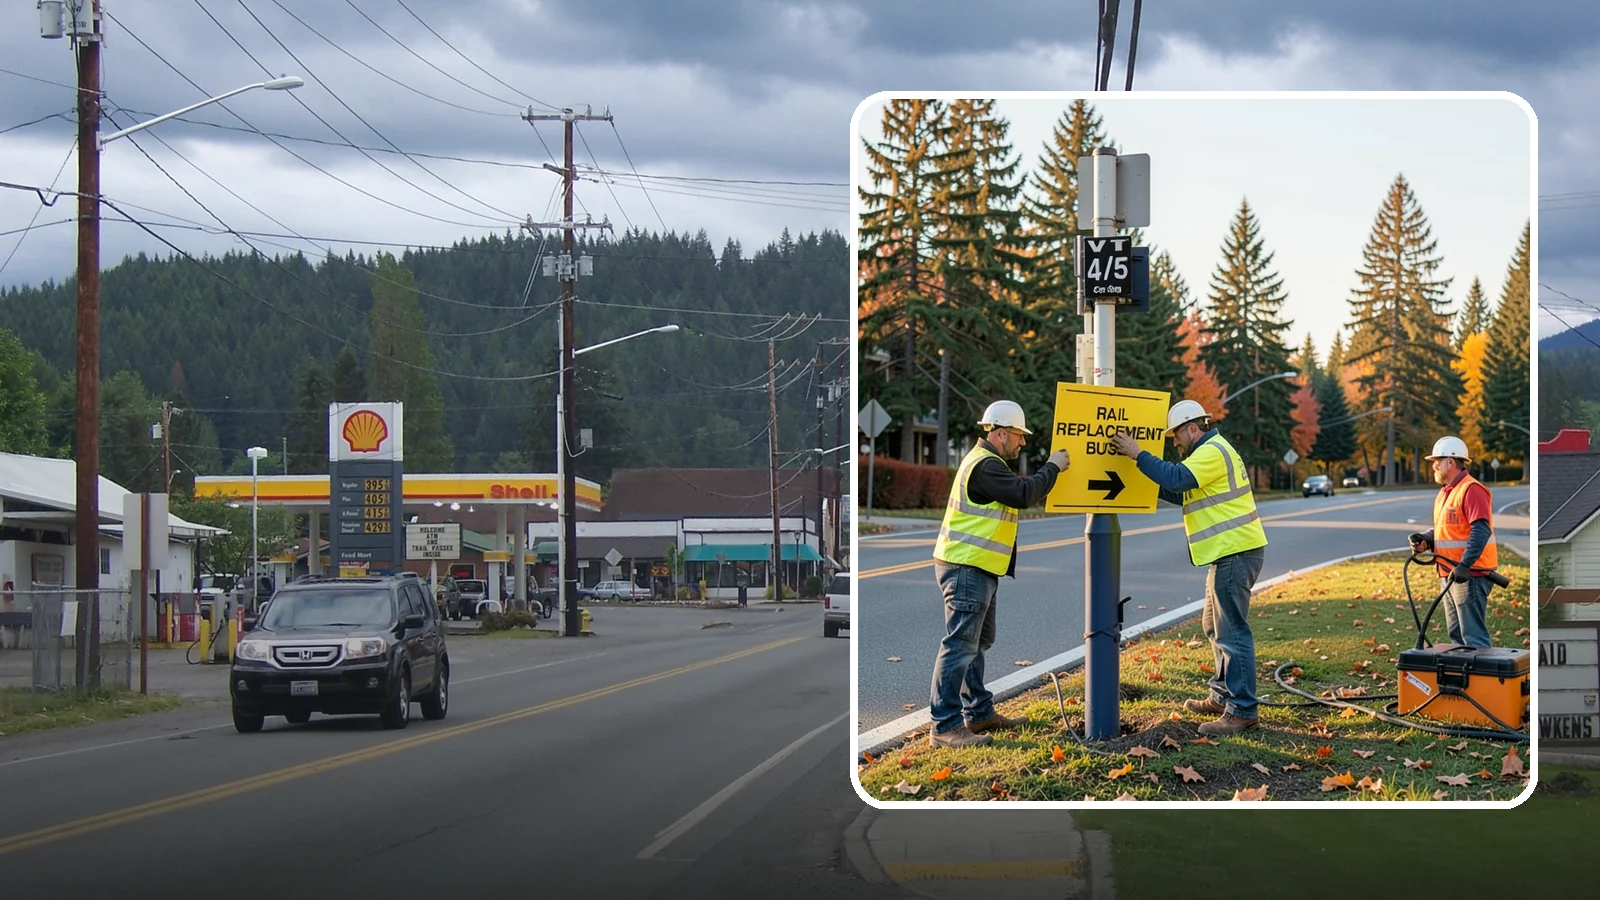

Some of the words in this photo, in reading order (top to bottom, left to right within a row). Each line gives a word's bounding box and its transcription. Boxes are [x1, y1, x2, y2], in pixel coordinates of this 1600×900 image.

[1087, 255, 1128, 281] 4/5
[1096, 406, 1129, 421] RAIL
[1056, 422, 1164, 441] REPLACEMENT
[365, 480, 383, 490] 395
[490, 484, 547, 499] Shell
[365, 494, 383, 504] 405
[365, 508, 383, 518] 415
[365, 522, 384, 533] 429
